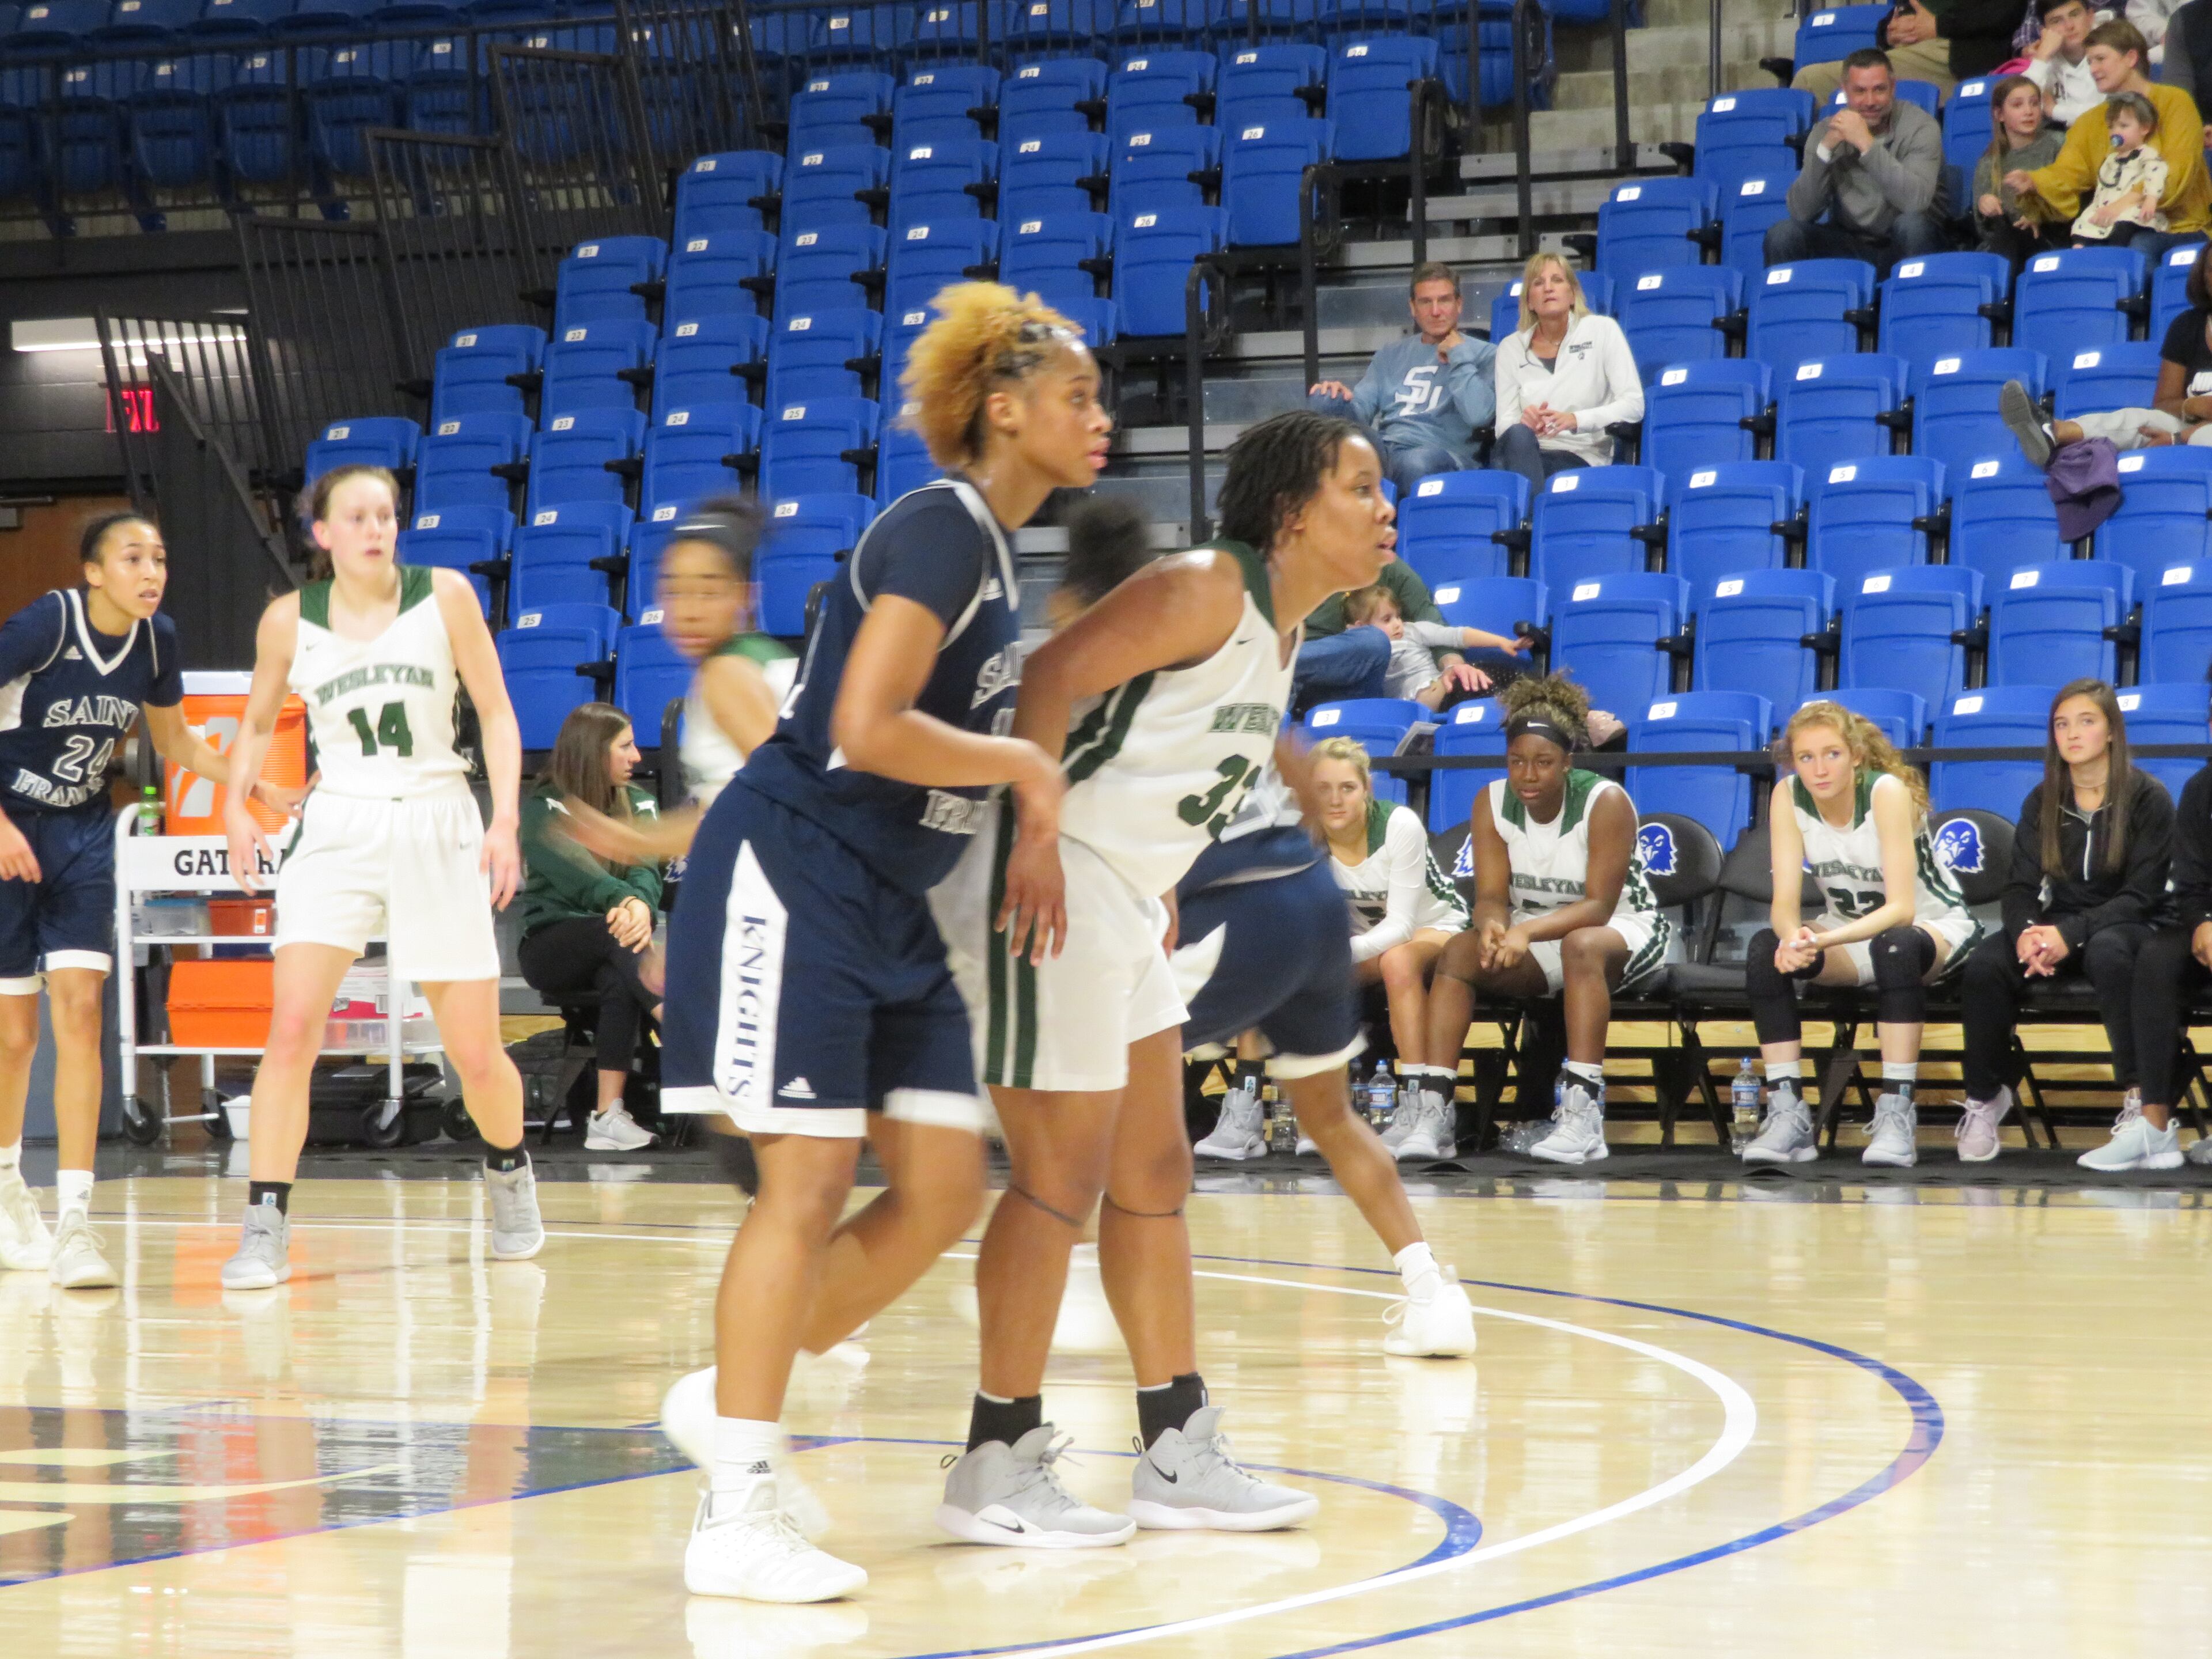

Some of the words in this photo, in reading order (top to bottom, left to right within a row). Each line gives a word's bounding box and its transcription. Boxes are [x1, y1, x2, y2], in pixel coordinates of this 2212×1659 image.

[908, 315, 919, 323] 25
[796, 321, 806, 329] 24
[682, 326, 694, 334] 23
[571, 331, 582, 339] 22
[789, 410, 800, 418] 25
[672, 415, 684, 423] 24
[558, 420, 569, 428] 23
[444, 425, 456, 433] 22
[781, 505, 792, 514] 26
[540, 514, 552, 522] 24
[658, 510, 671, 518] 25
[422, 517, 434, 527] 23
[524, 616, 535, 626] 25
[646, 613, 659, 622] 26
[313, 663, 435, 707] WESLEYAN
[347, 700, 413, 757] 14
[726, 915, 766, 1097] KNIGHTS
